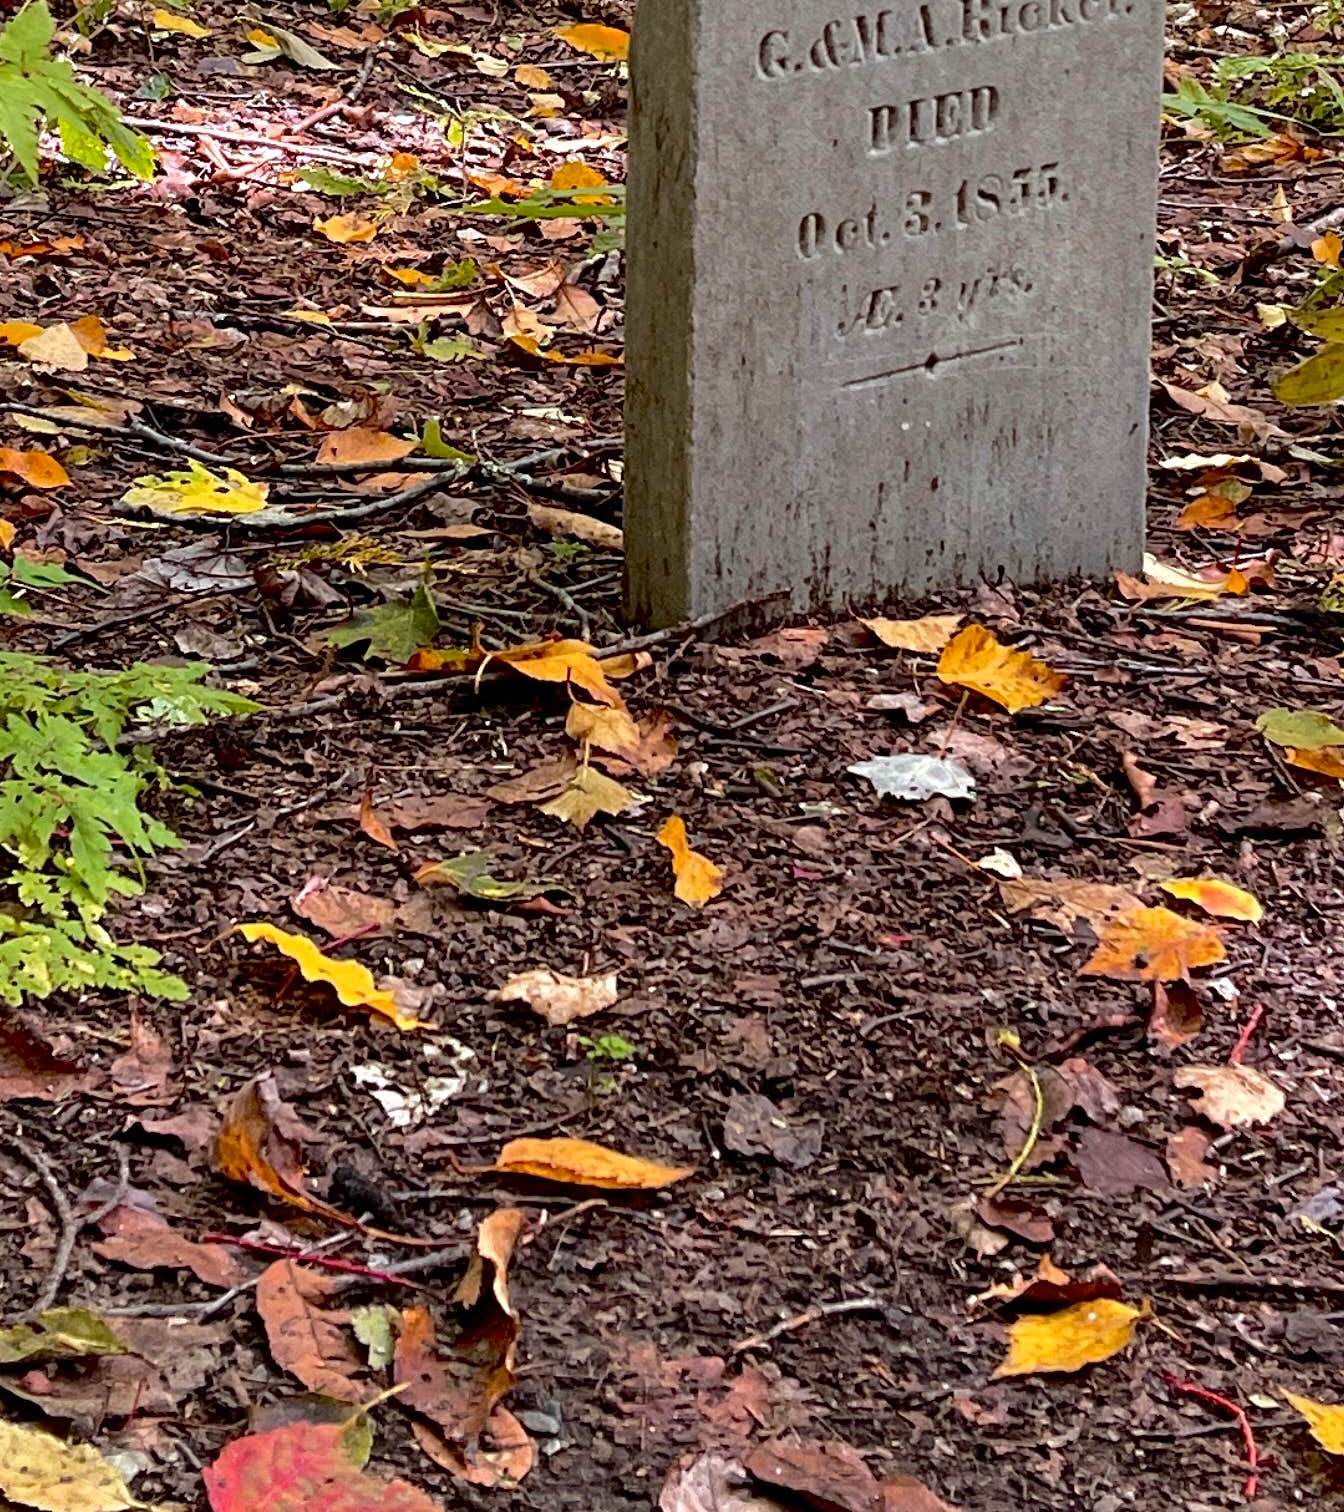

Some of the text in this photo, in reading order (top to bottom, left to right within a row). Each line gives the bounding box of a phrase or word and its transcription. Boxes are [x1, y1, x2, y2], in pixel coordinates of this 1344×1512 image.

[867, 86, 999, 155] DIED
[796, 197, 891, 259] Oct.
[917, 278, 941, 317] 3
